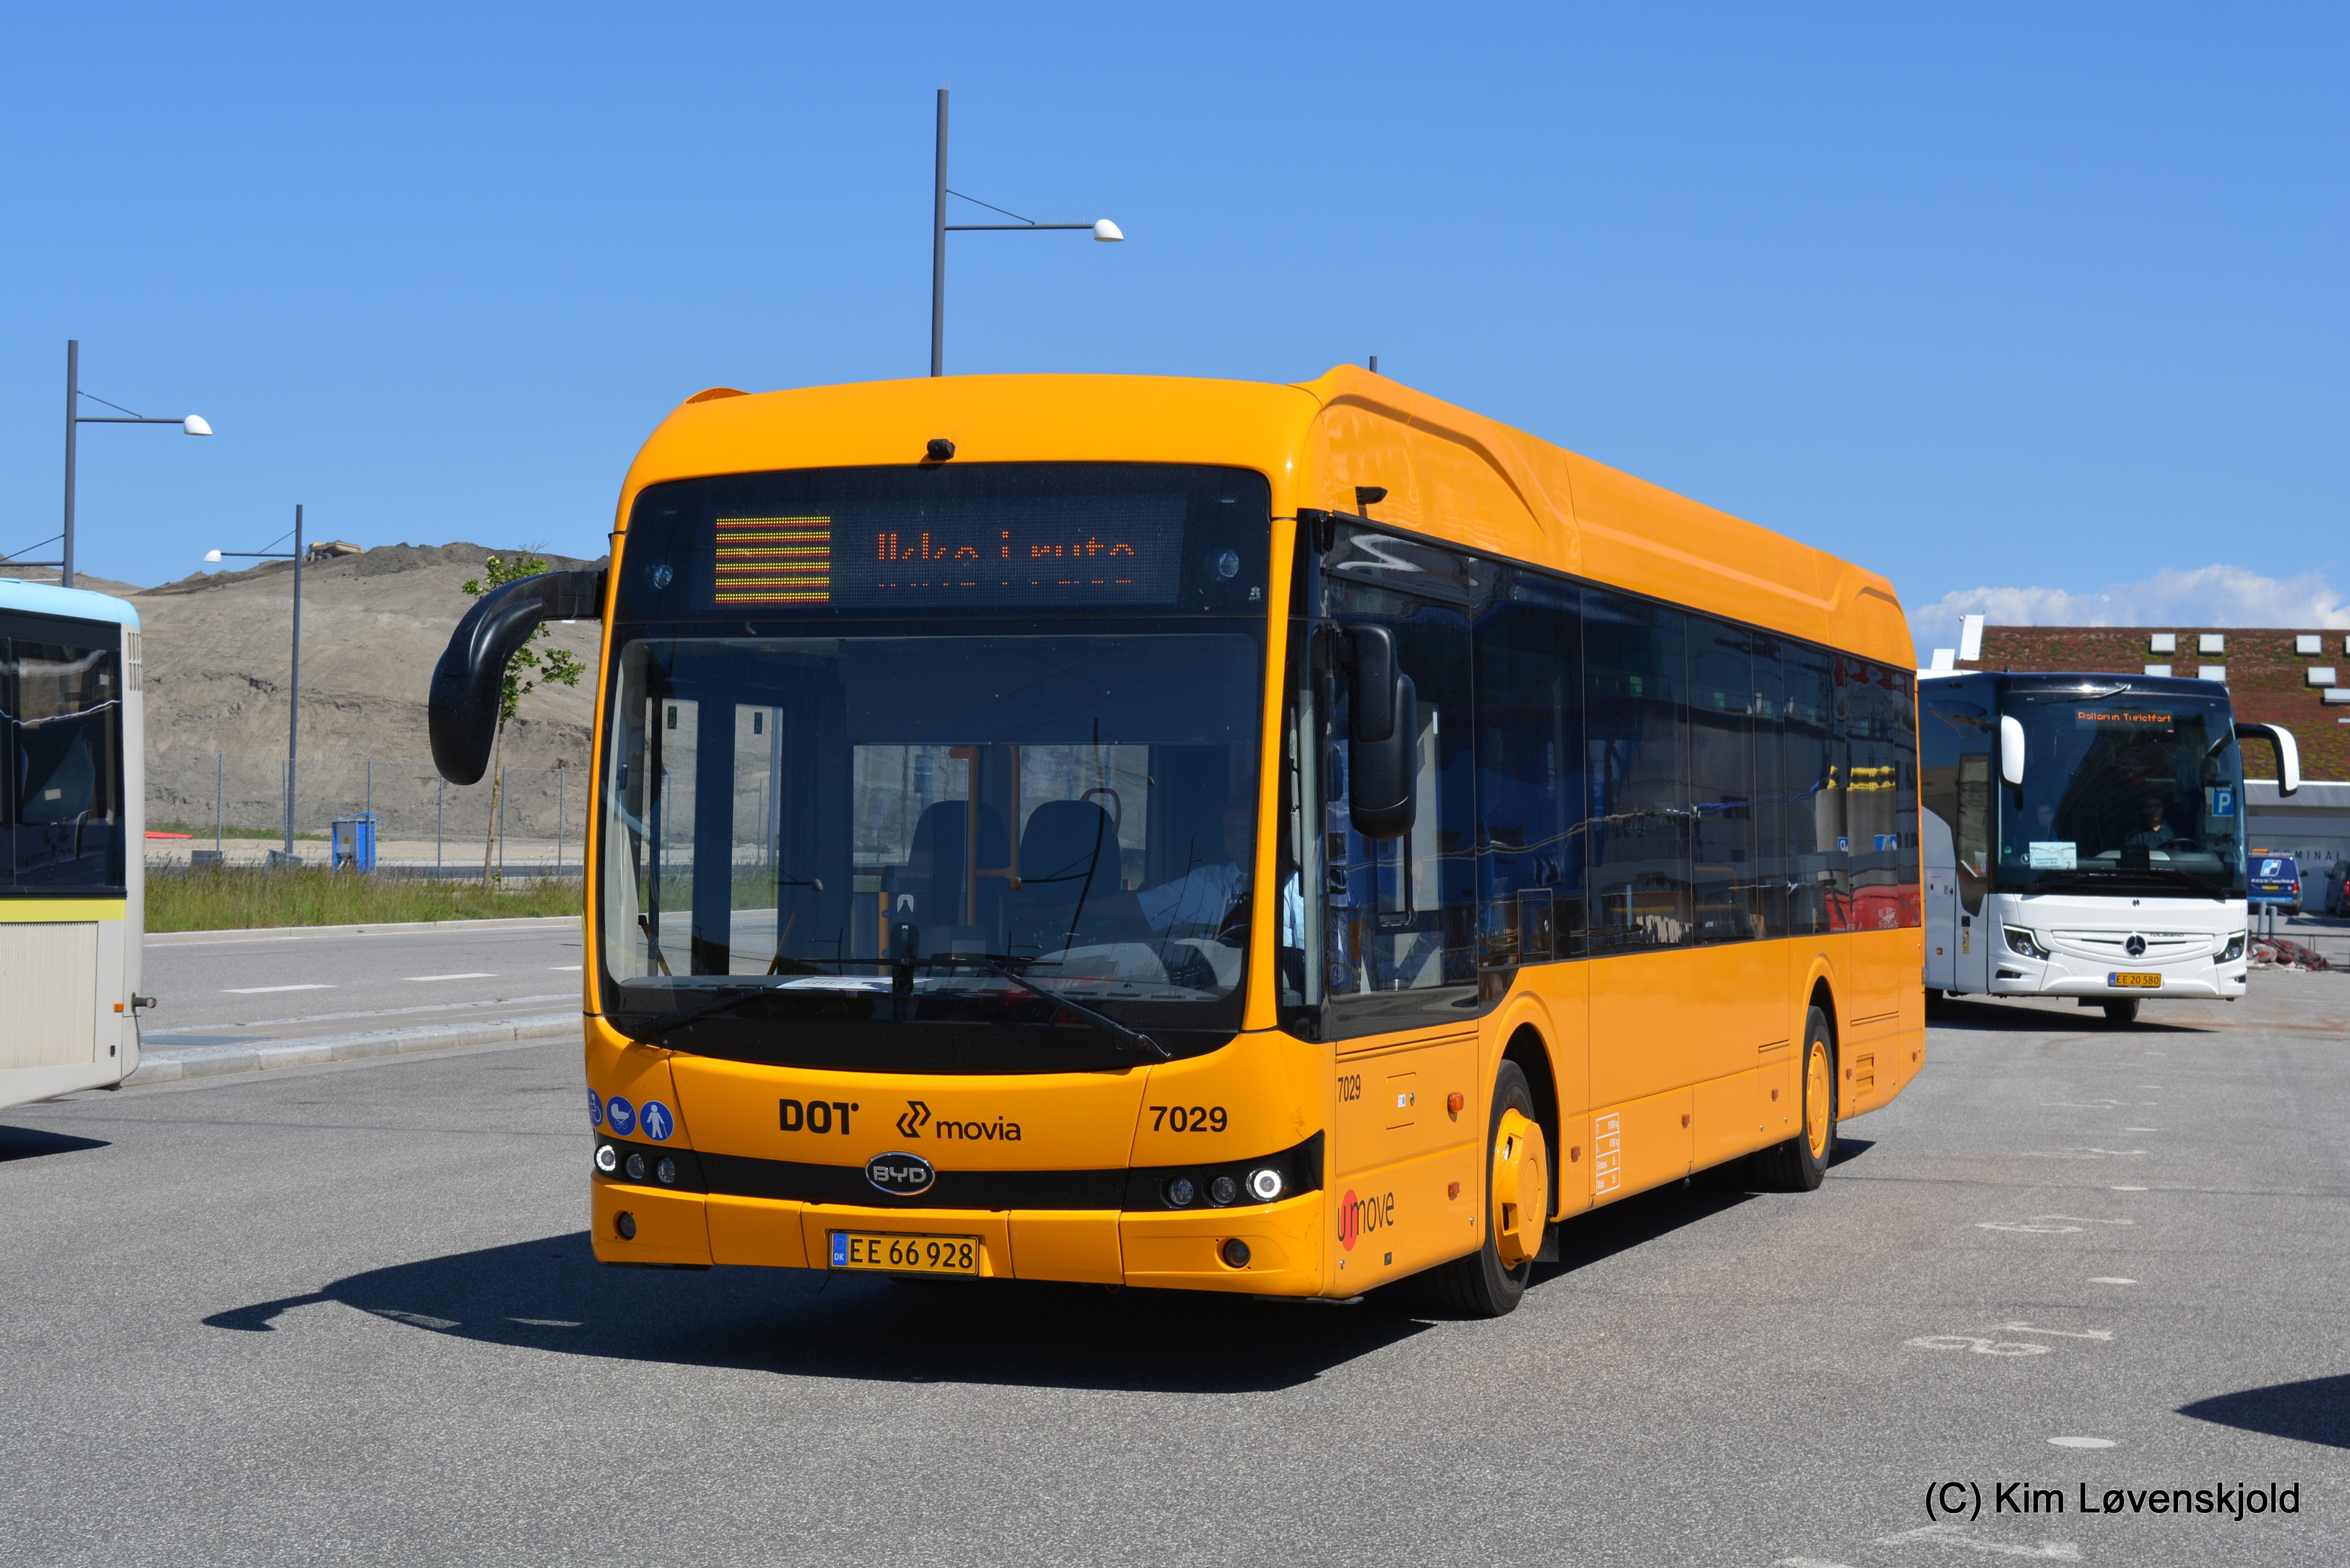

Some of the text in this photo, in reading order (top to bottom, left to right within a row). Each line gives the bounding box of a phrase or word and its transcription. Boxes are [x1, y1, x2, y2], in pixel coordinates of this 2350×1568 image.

[2116, 975, 2159, 985] EE 20 580
[1337, 1073, 1361, 1103] 7029
[779, 1098, 852, 1135] DOT
[936, 1115, 1022, 1142] movia
[1149, 1105, 1228, 1132] 7029
[873, 1165, 928, 1184] BYD
[1337, 1191, 1395, 1242] umove
[850, 1239, 974, 1269] EE 66 928
